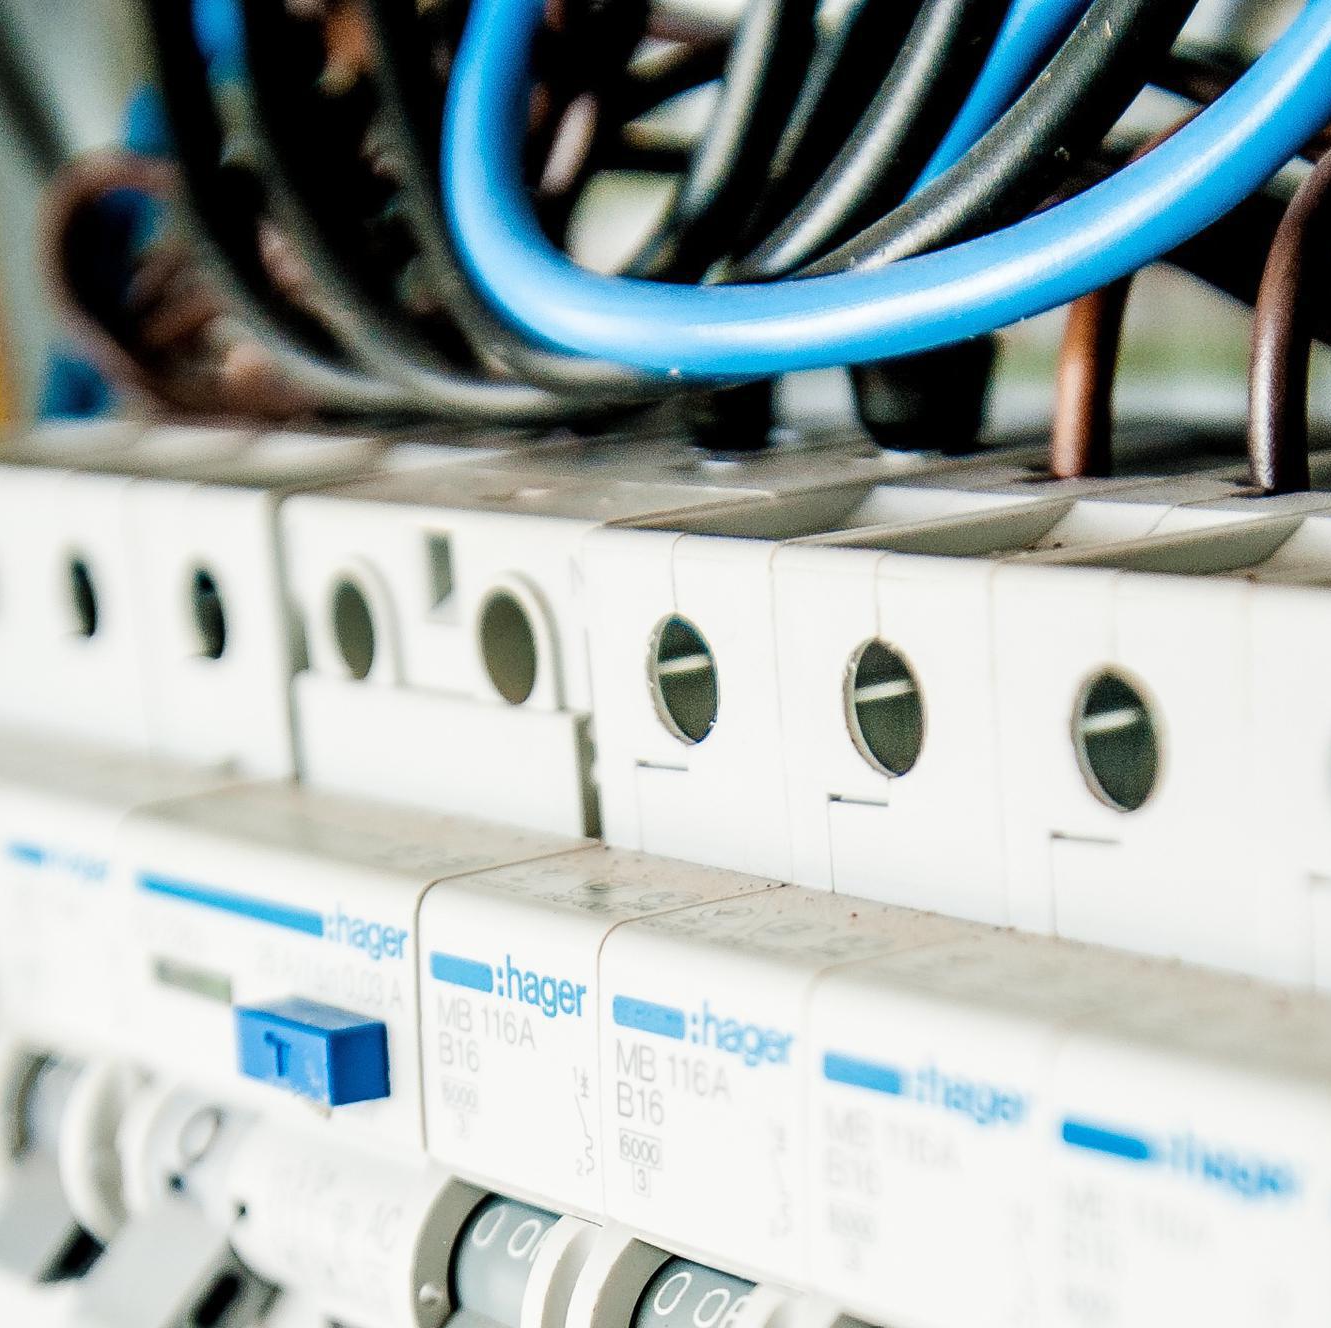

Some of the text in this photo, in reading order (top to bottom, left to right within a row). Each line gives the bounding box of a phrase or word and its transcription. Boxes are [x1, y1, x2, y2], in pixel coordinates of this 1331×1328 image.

[437, 993, 537, 1052] MB 116A
[438, 1030, 481, 1074] B16
[615, 1038, 733, 1104] MB 116A
[616, 1080, 666, 1127] B16
[621, 1133, 660, 1166] 6000
